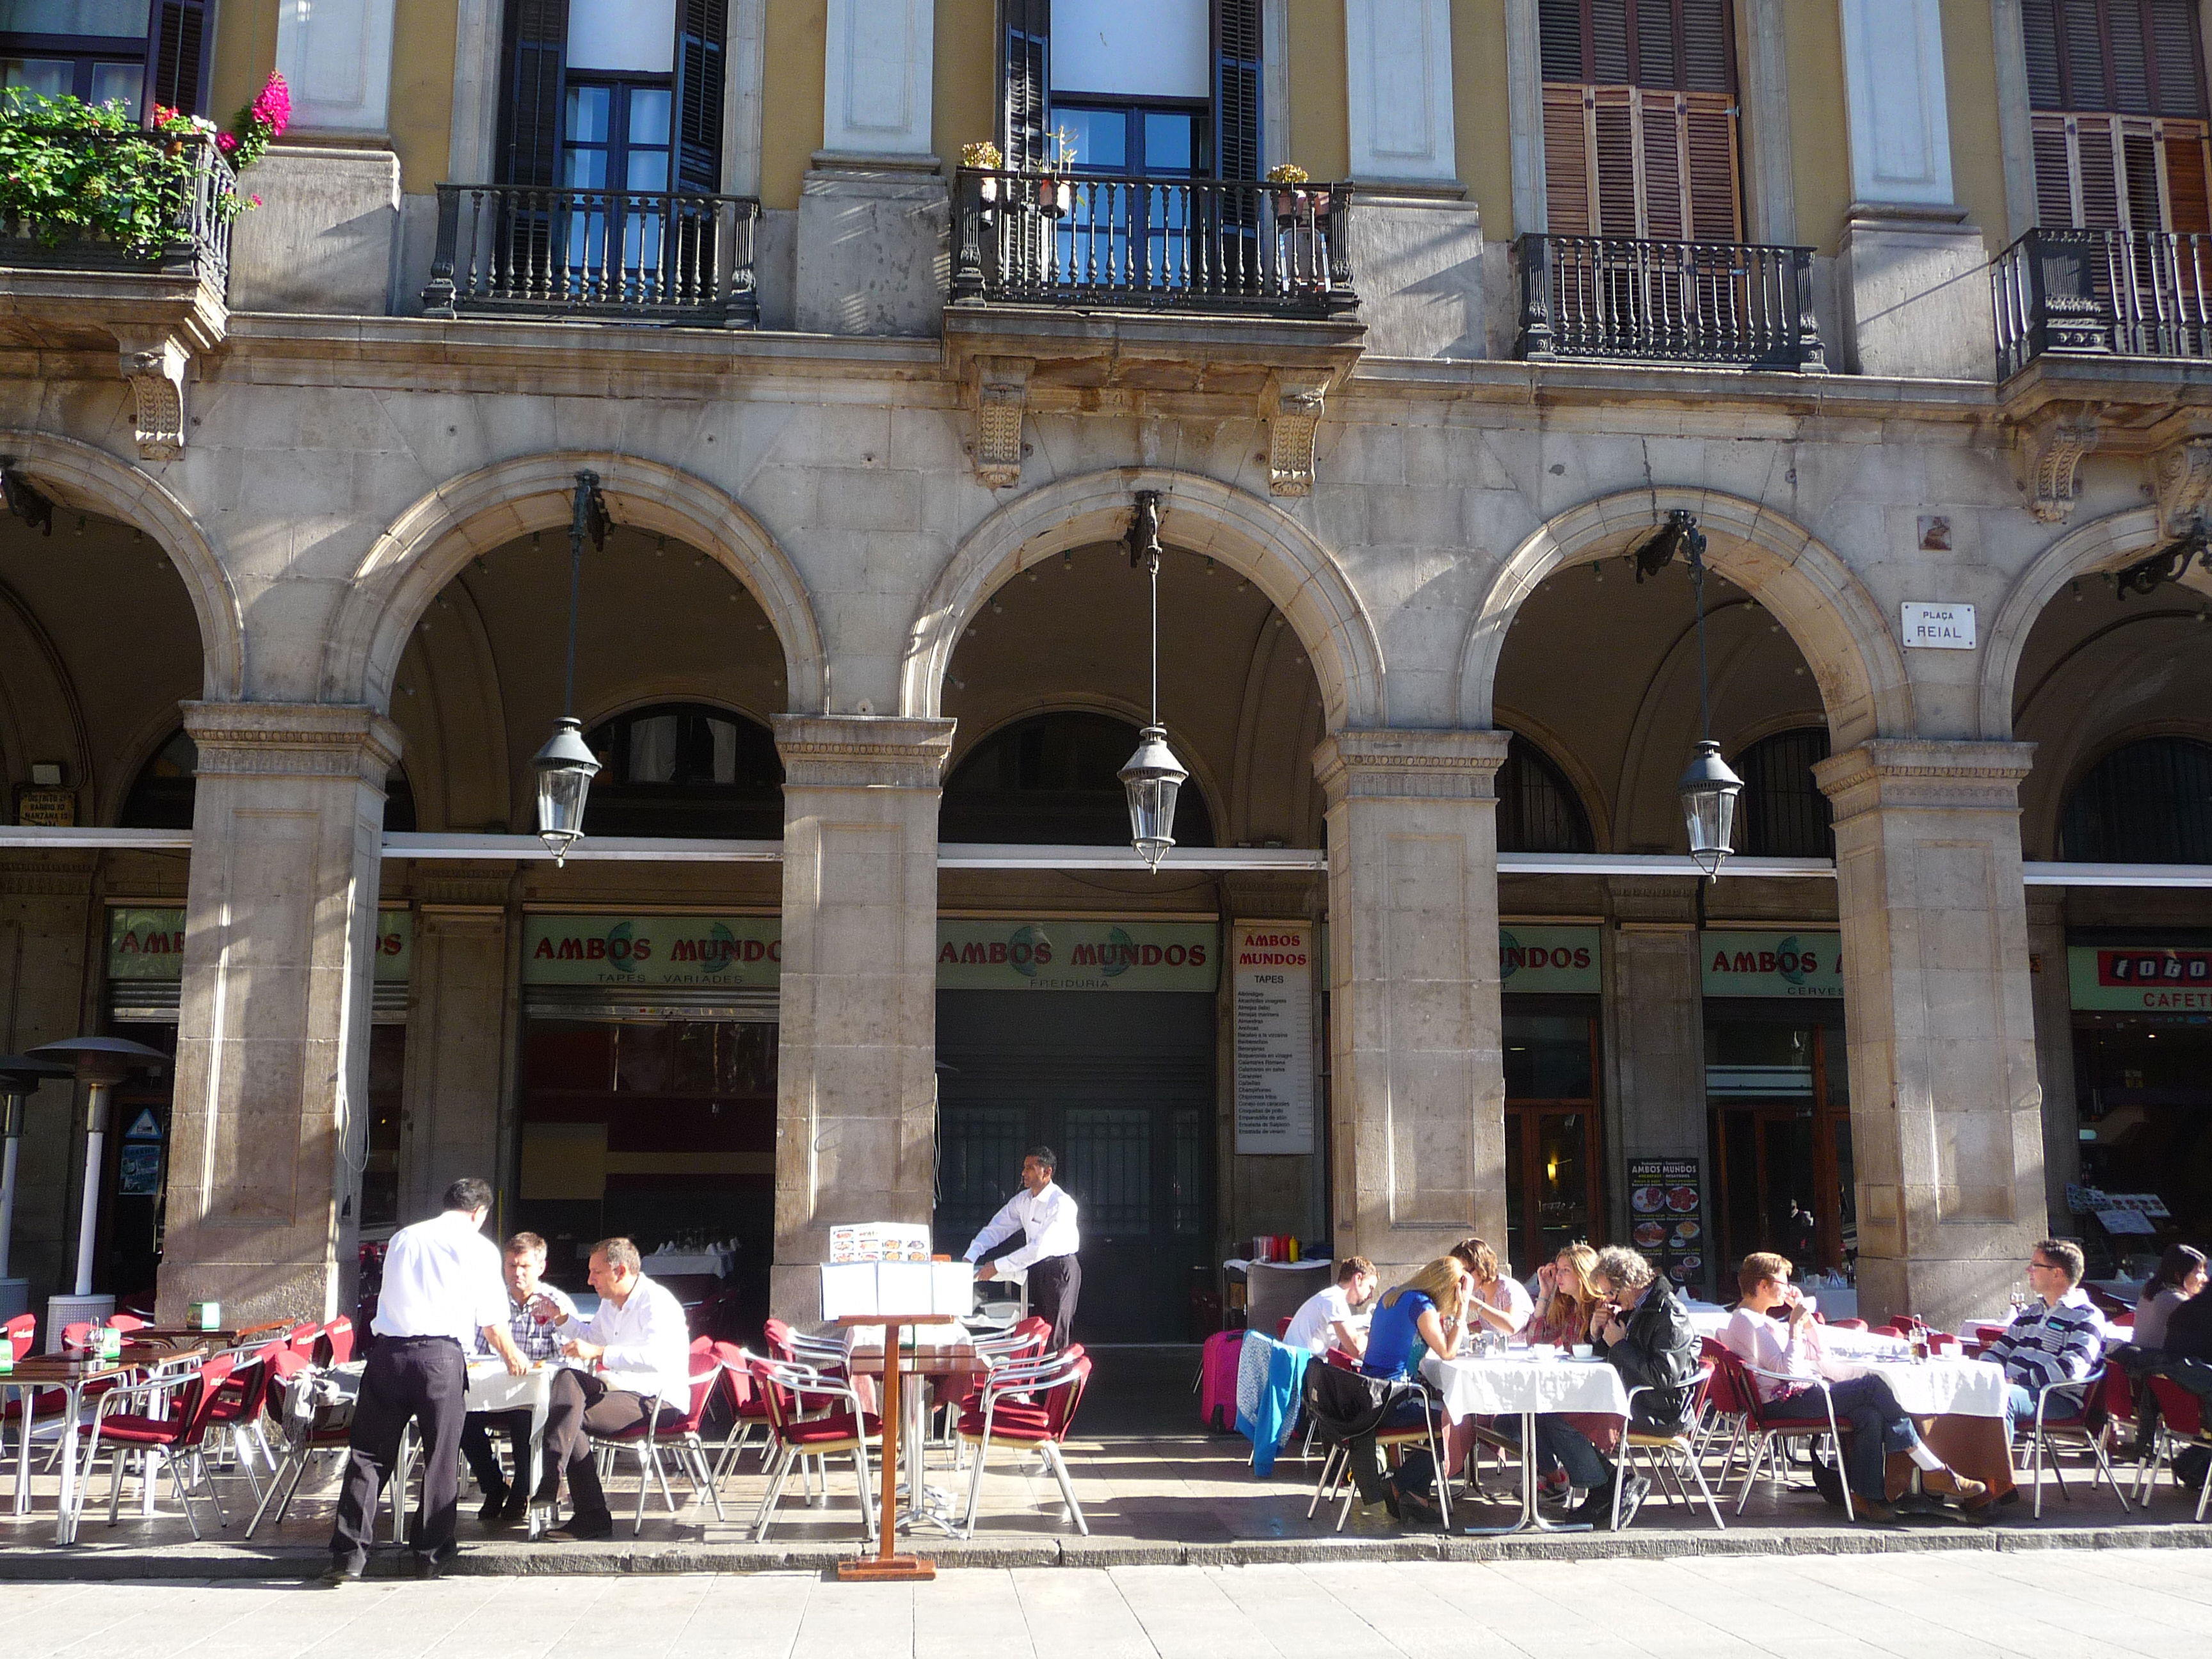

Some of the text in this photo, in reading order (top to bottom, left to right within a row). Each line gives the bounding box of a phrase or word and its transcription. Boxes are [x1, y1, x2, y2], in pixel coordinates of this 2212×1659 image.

[1923, 611, 1953, 621] PLAÇA
[1917, 626, 1962, 638] REIAL
[1244, 934, 1301, 947] AMBOS
[533, 936, 653, 961] AMBOS
[938, 941, 1206, 966] AMBOS MUNDOS
[1239, 952, 1307, 965] MUNDOS
[1500, 947, 1591, 968] NDOS
[1711, 950, 1818, 974] AMBOS
[598, 974, 743, 984] TAPES VARIADES
[1030, 979, 1109, 988] FREIDURIA
[1254, 975, 1284, 984] TAPES
[2144, 993, 2212, 1007] CAFET
[1632, 1165, 1697, 1173] AMBOS MUNDOS
